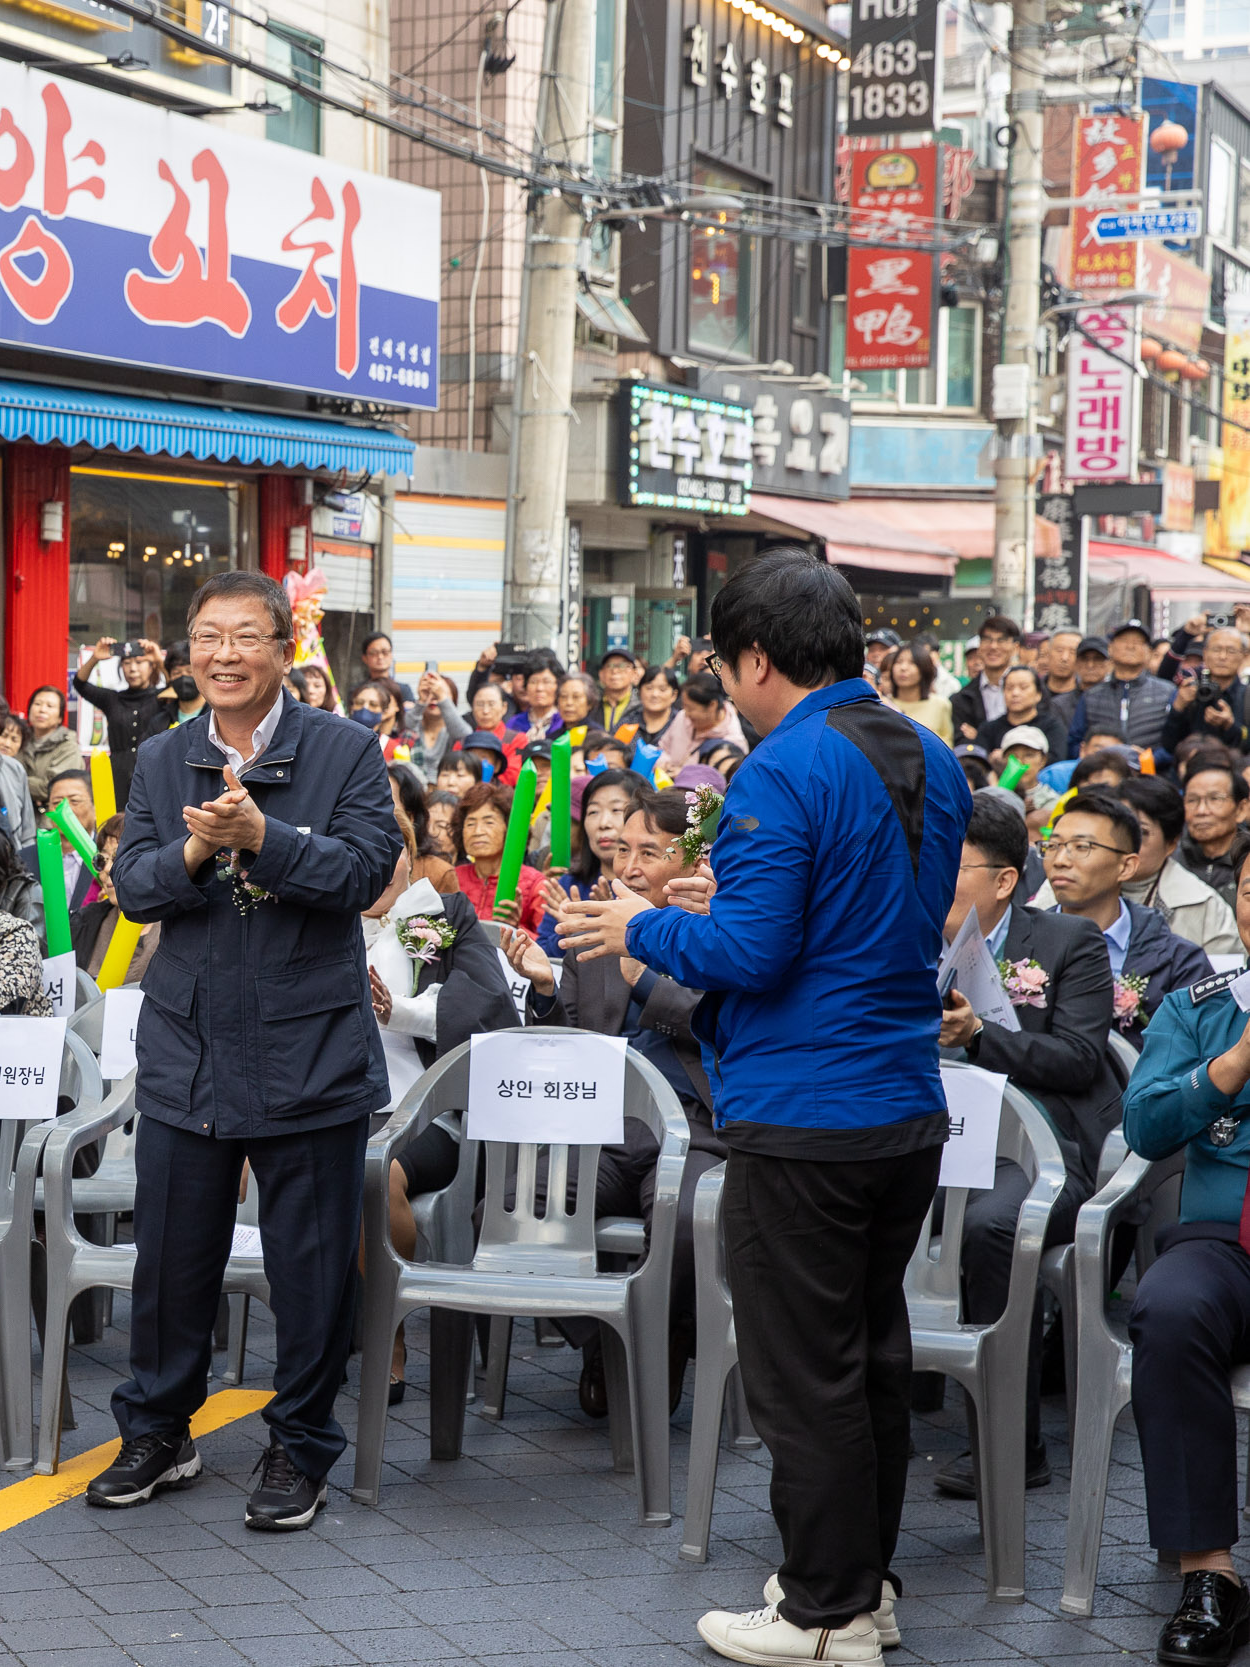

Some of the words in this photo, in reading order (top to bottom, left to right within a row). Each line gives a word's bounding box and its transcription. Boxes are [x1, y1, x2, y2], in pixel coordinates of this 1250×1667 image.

[205, 2, 230, 46] 2F
[850, 39, 934, 78] 463-
[850, 81, 929, 120] 1833
[639, 400, 753, 481] 천수호프
[497, 1079, 532, 1099] 상인
[543, 1081, 597, 1100] 회장님
